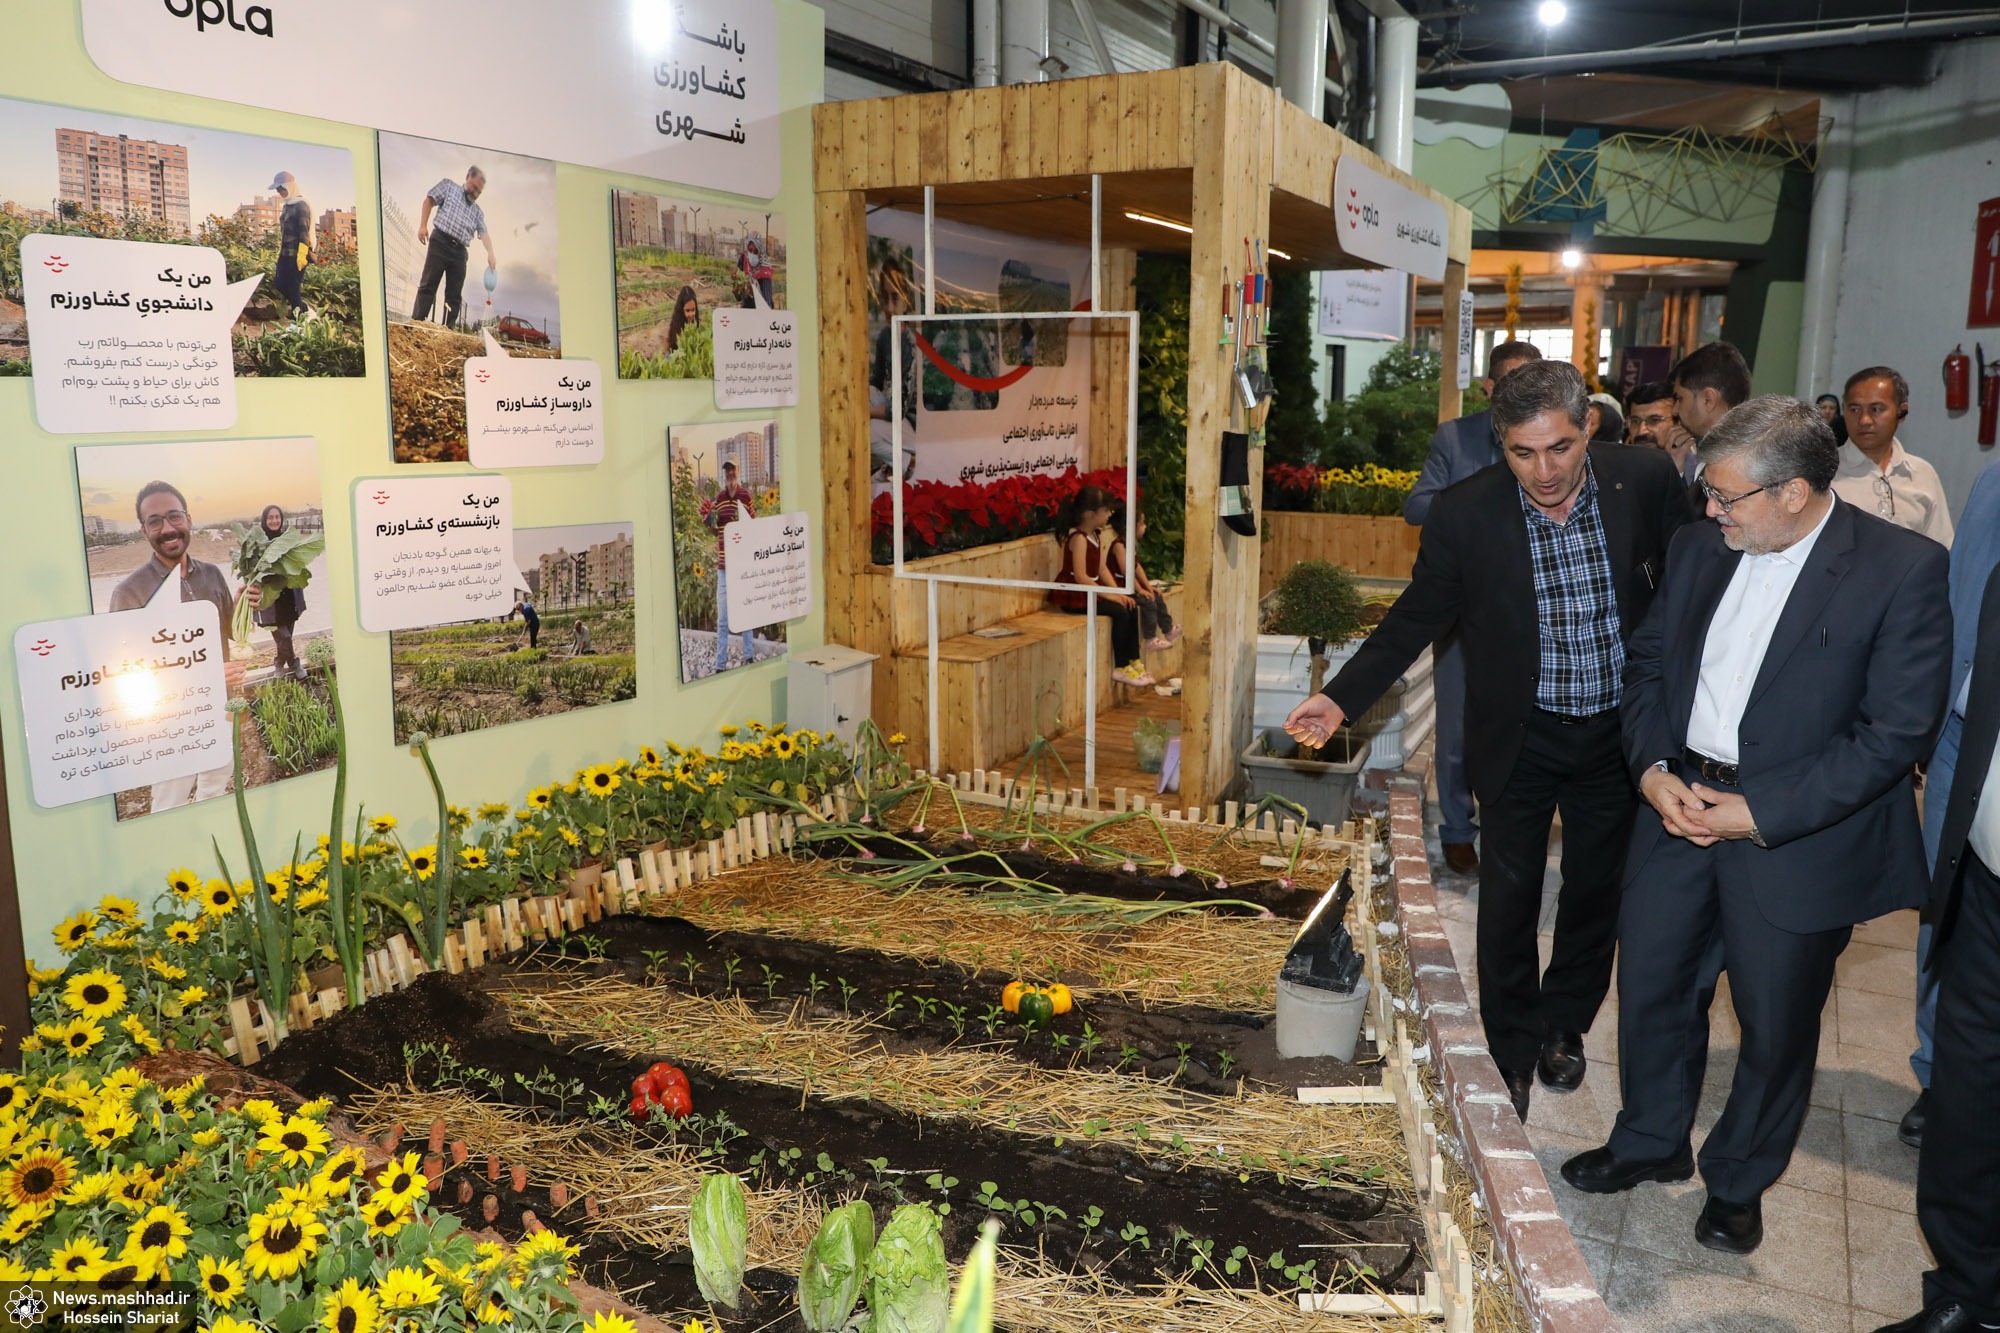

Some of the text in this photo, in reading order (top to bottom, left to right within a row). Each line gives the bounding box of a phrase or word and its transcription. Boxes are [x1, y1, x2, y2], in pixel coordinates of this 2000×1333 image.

[164, 0, 273, 38] opla
[654, 60, 745, 100] کشاورزی
[656, 110, 745, 144] شهری
[1363, 202, 1379, 229] opla
[158, 268, 211, 288] من یک
[51, 291, 130, 309] کشاورزم
[770, 321, 791, 333] من یک
[78, 338, 94, 349] رب
[166, 339, 173, 350] با
[734, 338, 767, 351] کشاورزم
[121, 357, 142, 368] کنم
[146, 357, 179, 368] درست
[183, 356, 218, 370] خونگی
[101, 377, 130, 390] پشت
[133, 379, 139, 388] و
[143, 376, 168, 386] حیاط
[171, 377, 191, 389] برای
[194, 377, 219, 389] کاش
[558, 376, 591, 391] من یک
[119, 395, 147, 408] بکنم
[151, 395, 180, 408] فکری
[183, 395, 199, 407] یک
[203, 396, 221, 408] هم
[496, 396, 547, 411] کشاورزم
[483, 426, 510, 435] بیشتر
[569, 424, 593, 433] احساس
[1003, 426, 1029, 443] اجتماعی
[1056, 423, 1078, 439] افزایش
[556, 438, 593, 448] دوست دارم
[960, 460, 984, 480] شهری
[1031, 455, 1055, 472] اجتماعی
[463, 494, 500, 508] من یک
[376, 517, 433, 536] کشاورزم
[783, 526, 804, 537] من یک
[425, 547, 447, 558] گوجه
[450, 548, 472, 558] همین
[474, 546, 491, 554] بهانه
[754, 542, 785, 560] کشاورزم
[393, 551, 423, 563] بادنجان
[441, 566, 449, 574] رو
[451, 562, 483, 573] همسایه
[484, 560, 502, 571] امروز
[374, 571, 383, 581] تو
[385, 569, 407, 580] وقتی
[408, 568, 414, 578] از
[376, 575, 502, 597] این باشگاه عضو شدیم حالمون
[466, 590, 502, 600] خیلی خوبه
[152, 627, 205, 645] من یک
[182, 687, 194, 701] کار
[198, 685, 211, 696] چه
[194, 703, 213, 715] هم
[115, 720, 121, 729] با
[187, 721, 215, 736] تفریح
[100, 736, 144, 754] محصول
[52, 746, 97, 761] برداشت
[132, 750, 152, 765] کلی
[156, 747, 175, 760] هم
[80, 754, 129, 777] اقتصادی
[60, 766, 77, 780] تره
